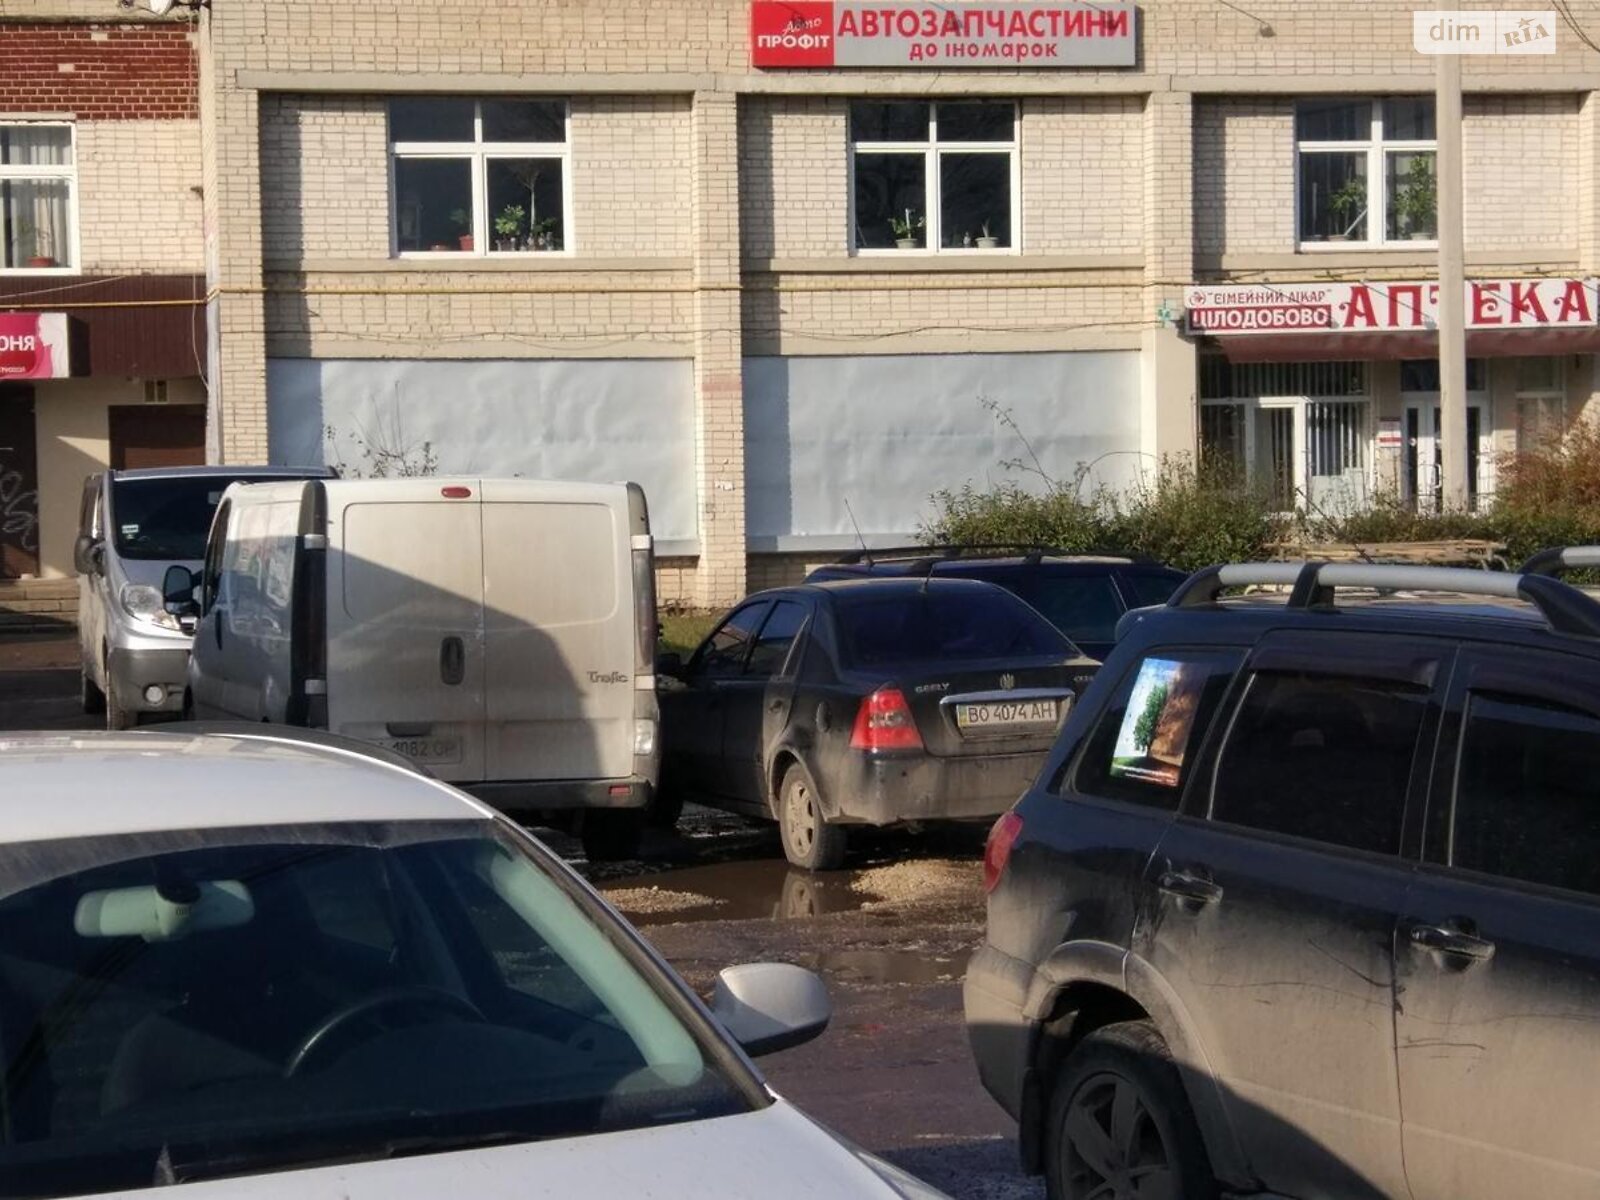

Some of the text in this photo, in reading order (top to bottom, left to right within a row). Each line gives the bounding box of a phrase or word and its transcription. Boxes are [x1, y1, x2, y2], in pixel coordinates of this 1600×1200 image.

[837, 8, 1127, 38] АВТОЗАПЧАСТИНИ
[757, 34, 830, 49] ПРОФІТ
[909, 42, 937, 61] до
[1192, 307, 1328, 329] ЦІЛОДОБОВО
[587, 671, 628, 684] Trafic
[993, 703, 1028, 722] 4074
